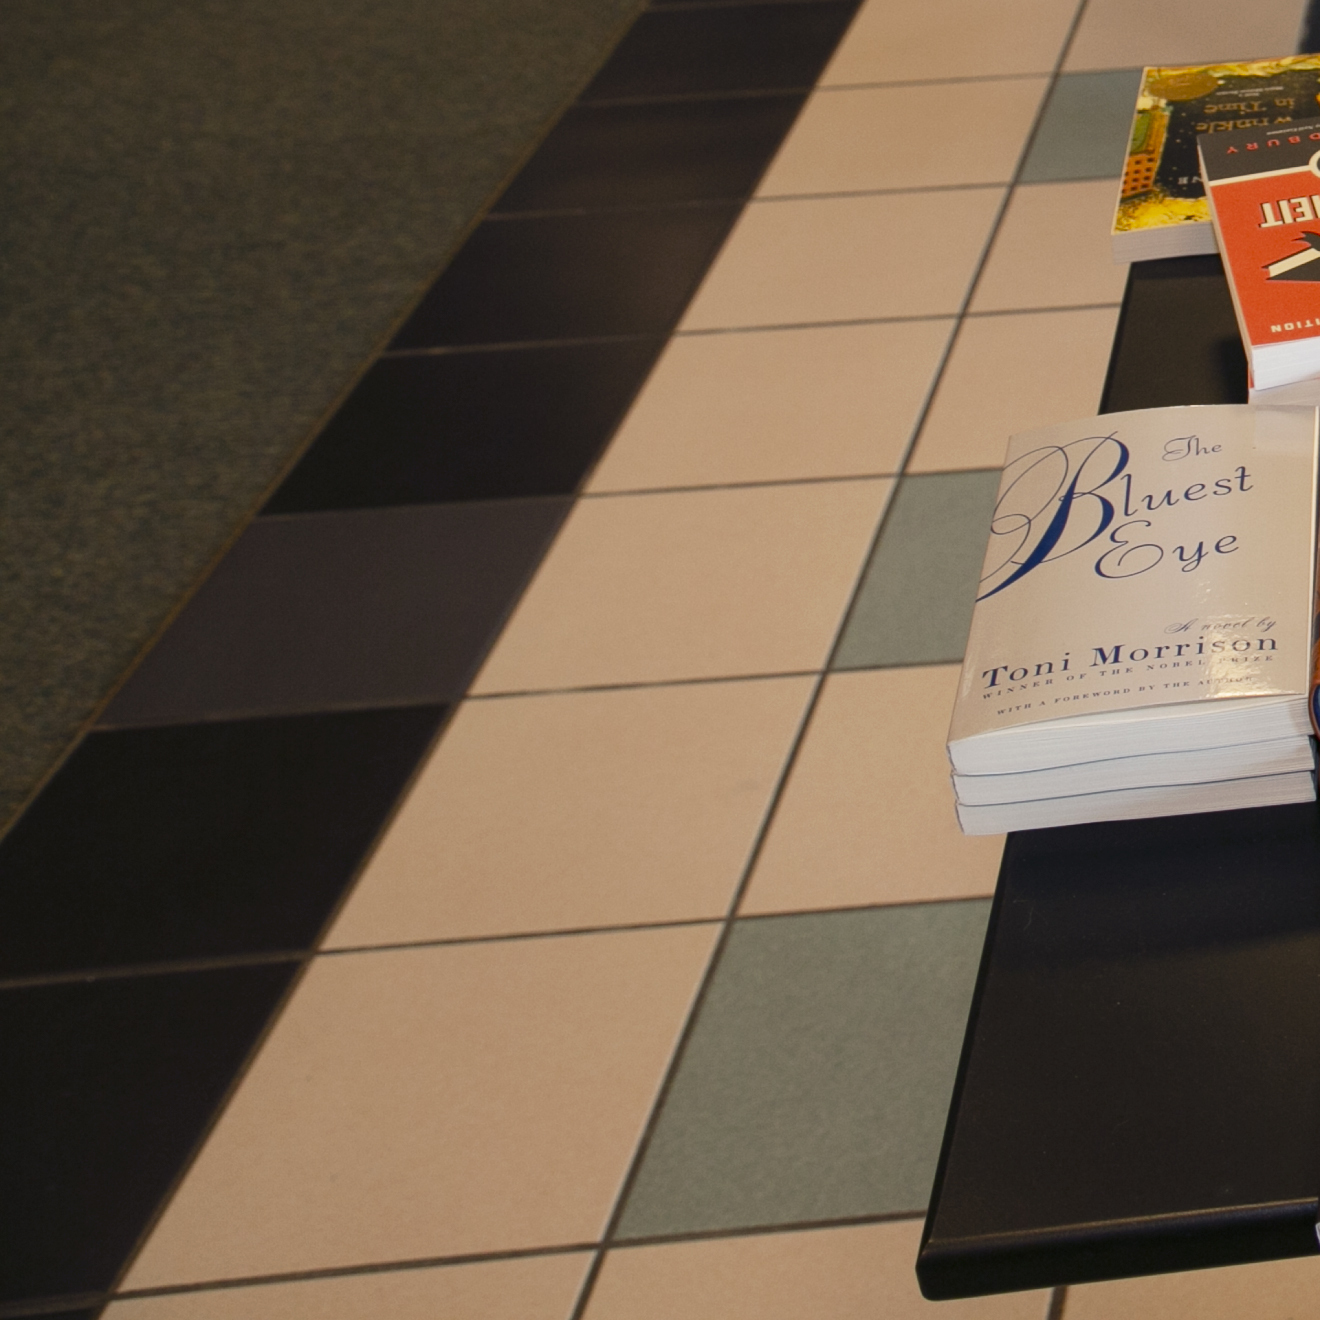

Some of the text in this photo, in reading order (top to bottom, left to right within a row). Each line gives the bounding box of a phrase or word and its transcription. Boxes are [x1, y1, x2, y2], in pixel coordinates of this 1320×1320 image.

[1204, 101, 1266, 115] Time
[1162, 434, 1224, 462] The
[975, 431, 1254, 603] Bluest
[1094, 520, 1240, 579] Eye
[981, 635, 1279, 689] Toni Morrison
[982, 654, 1275, 700] WINNER NOBEL PRIZE
